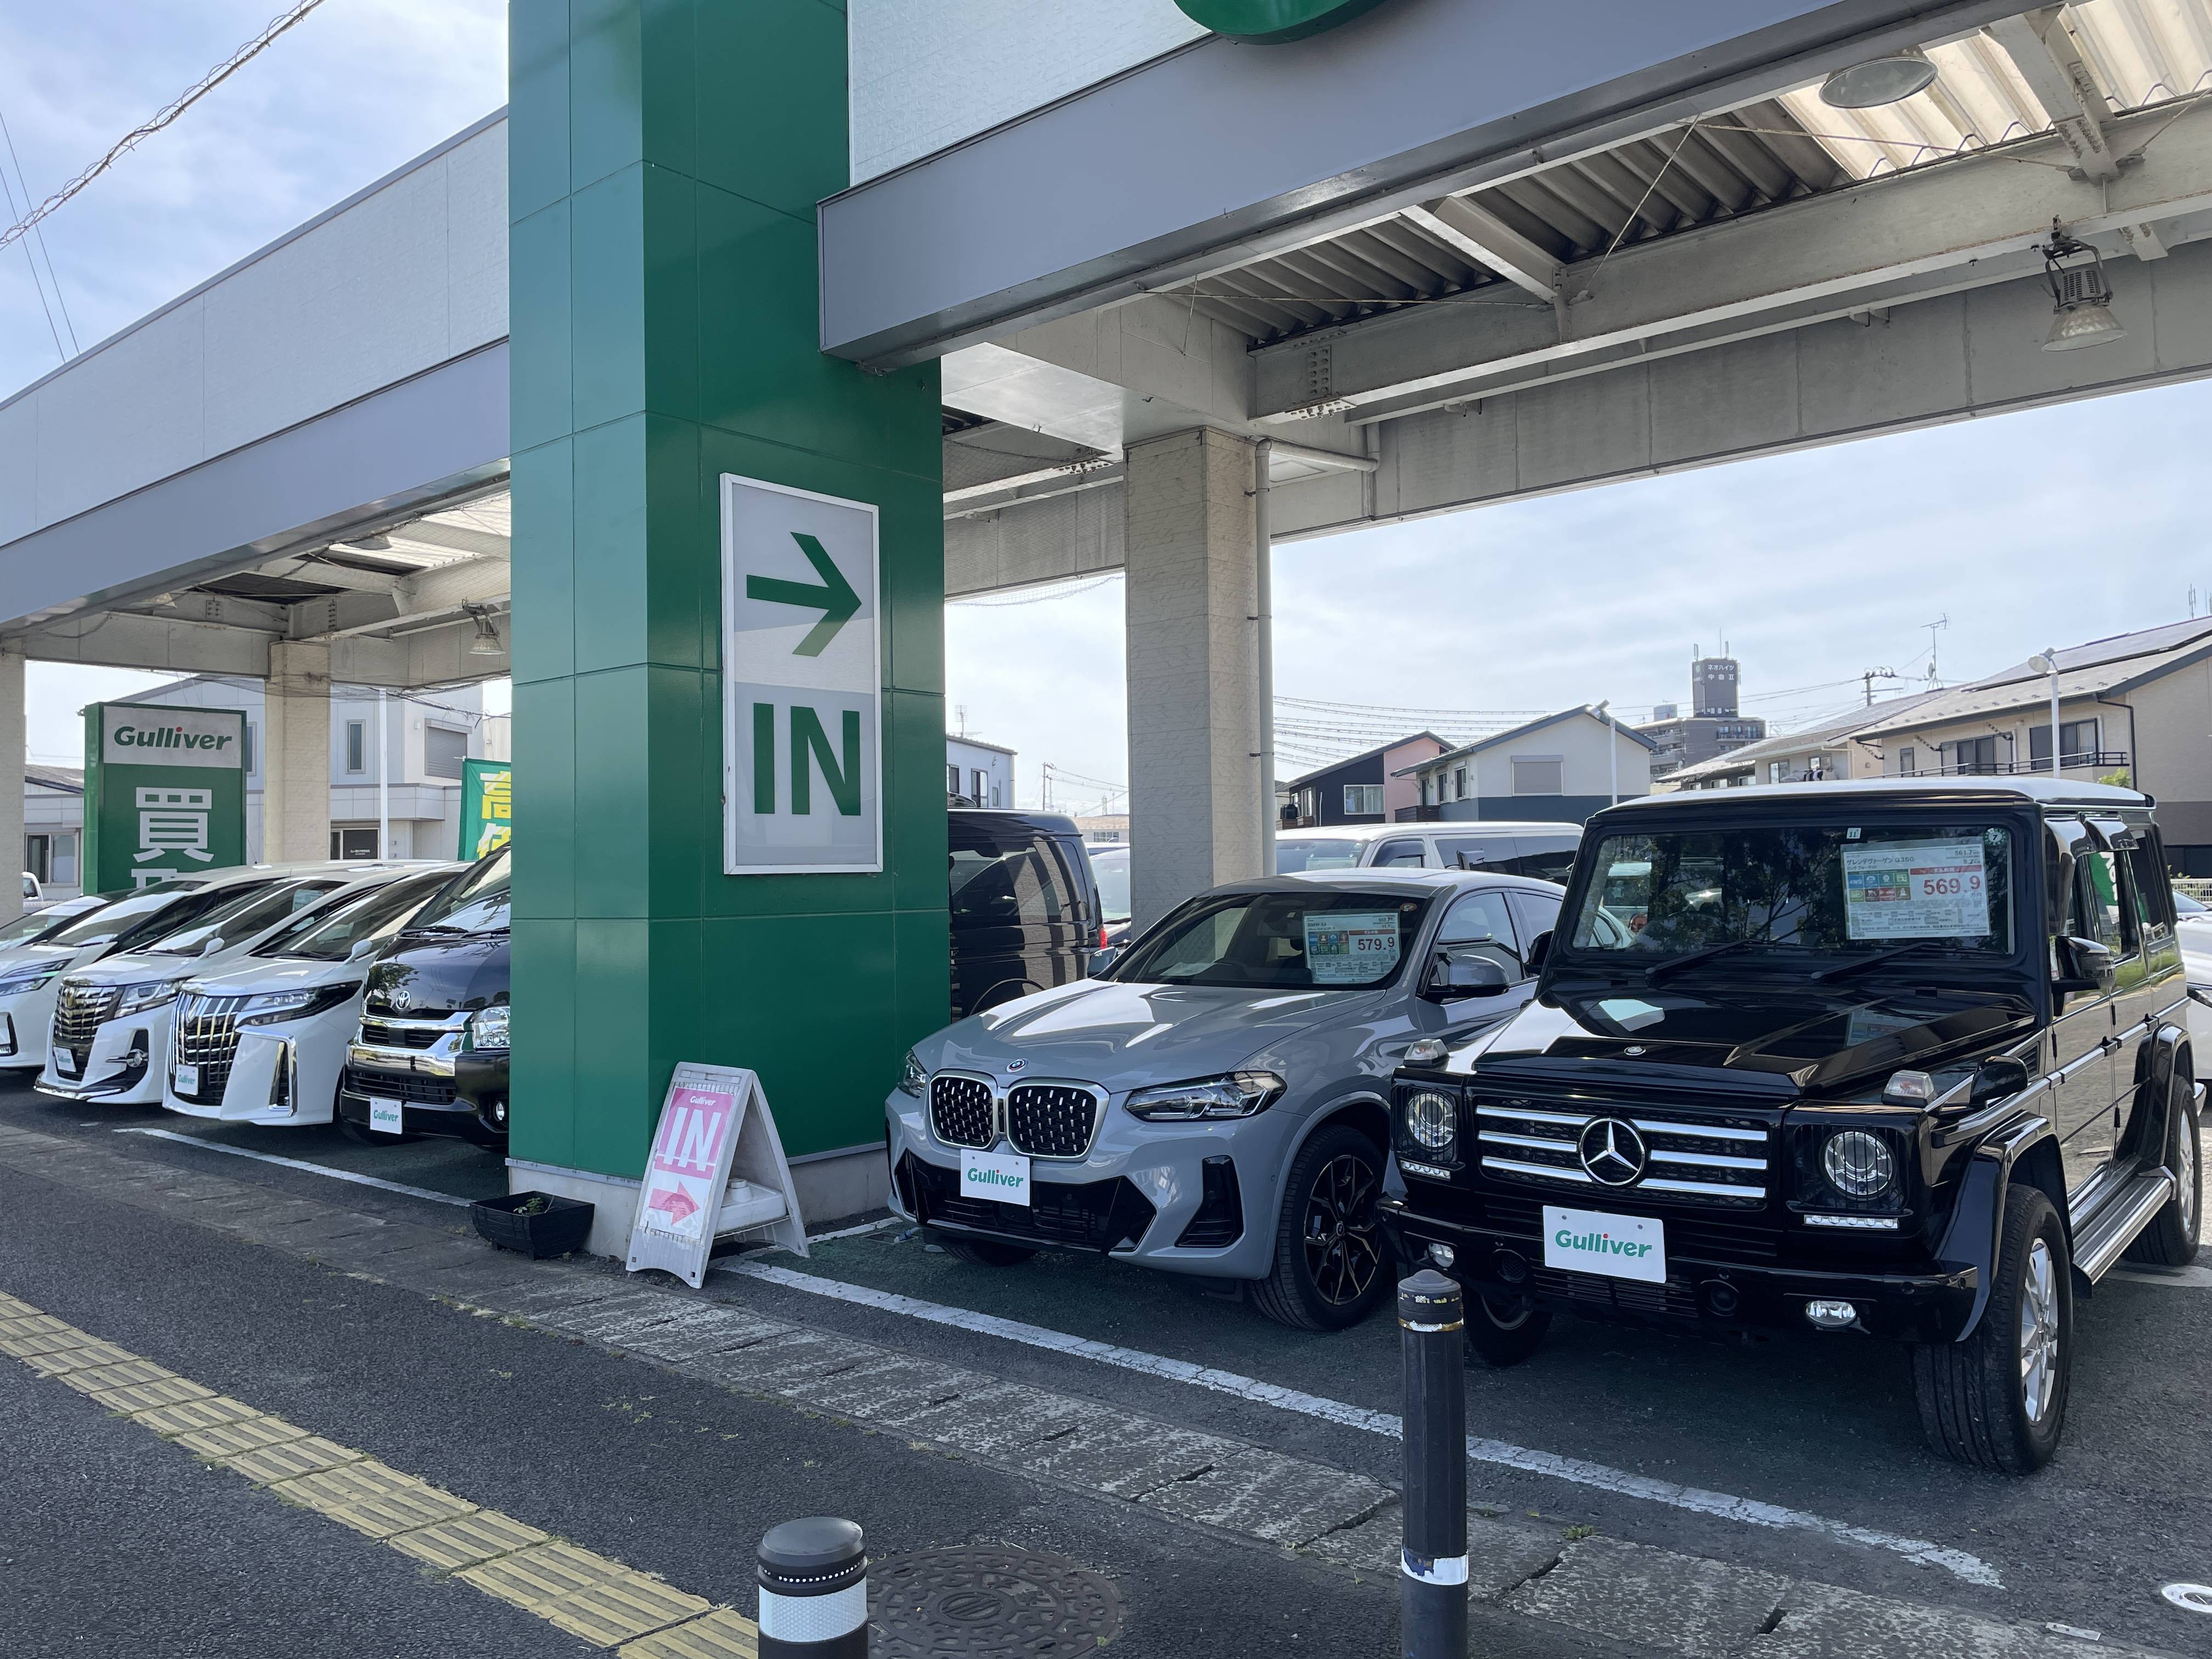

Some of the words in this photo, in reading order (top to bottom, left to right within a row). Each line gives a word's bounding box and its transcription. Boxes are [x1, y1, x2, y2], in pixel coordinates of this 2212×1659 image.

[114, 726, 233, 751] Gulliver
[753, 702, 861, 816] IN
[131, 787, 215, 888] 買
[1923, 875, 1981, 895] 569.9
[1358, 936, 1395, 951] 579.9
[690, 1096, 716, 1106] Gulliver
[374, 1109, 399, 1122] Gulliver
[663, 1106, 722, 1171] IN
[967, 1167, 1024, 1188] Gulliver
[1555, 1229, 1652, 1257] Gulliver
